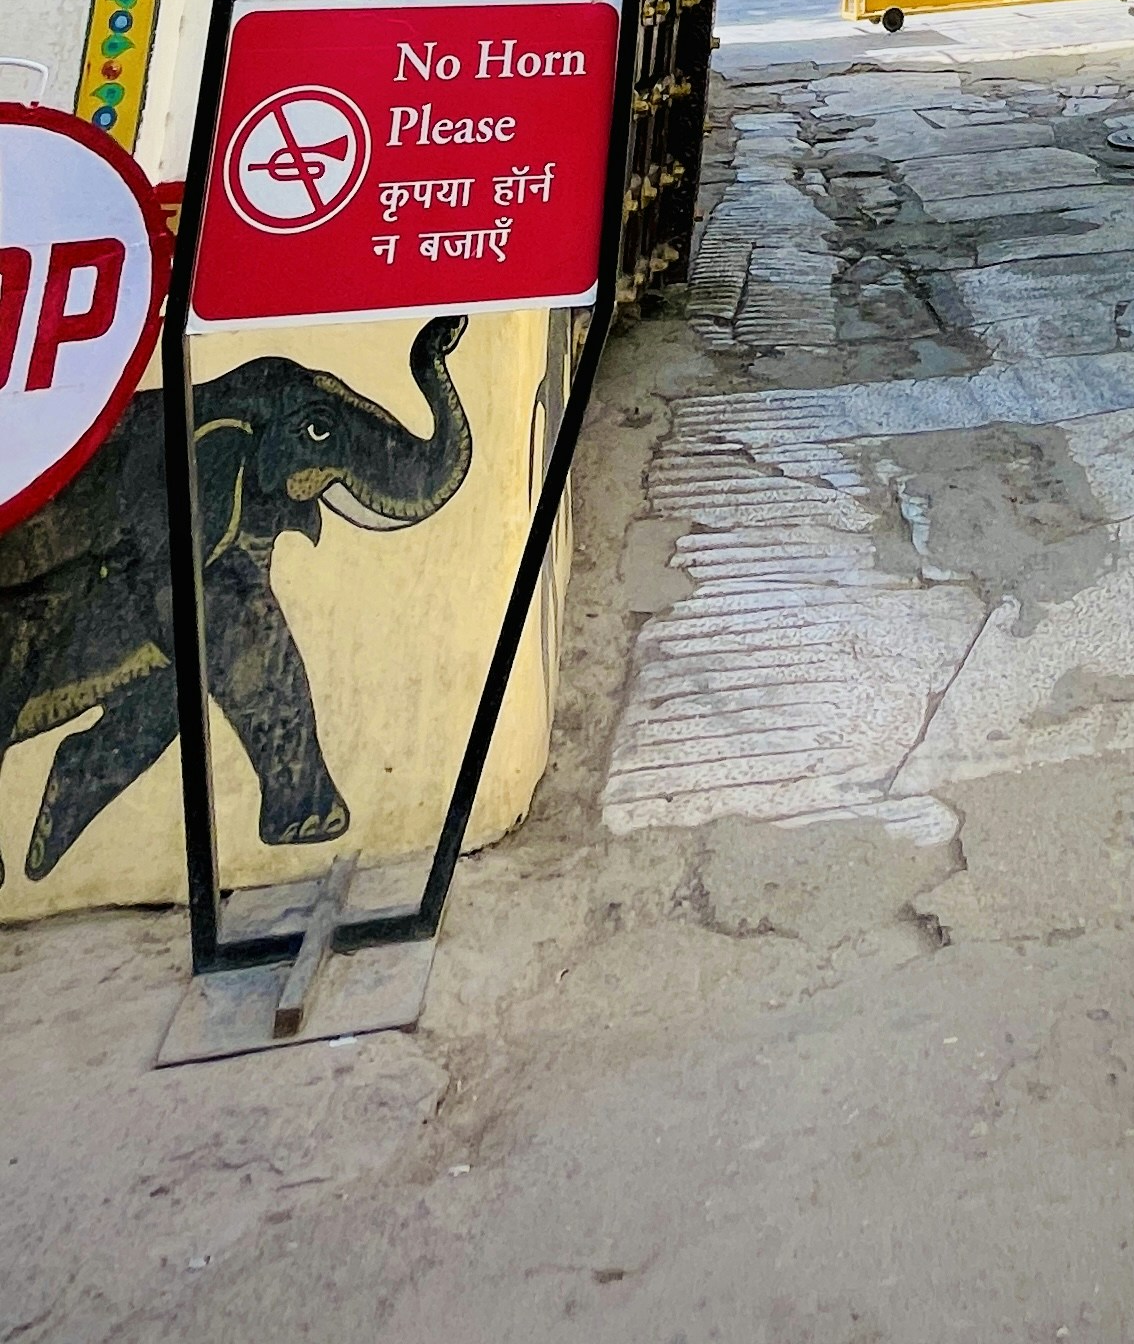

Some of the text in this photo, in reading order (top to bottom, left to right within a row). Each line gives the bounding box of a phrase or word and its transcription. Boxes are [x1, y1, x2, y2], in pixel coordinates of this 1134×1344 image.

[393, 39, 587, 82] No Horn
[385, 102, 517, 147] Please
[378, 162, 556, 222] कृपया हॉर्न
[371, 216, 514, 265] न बजाएँ
